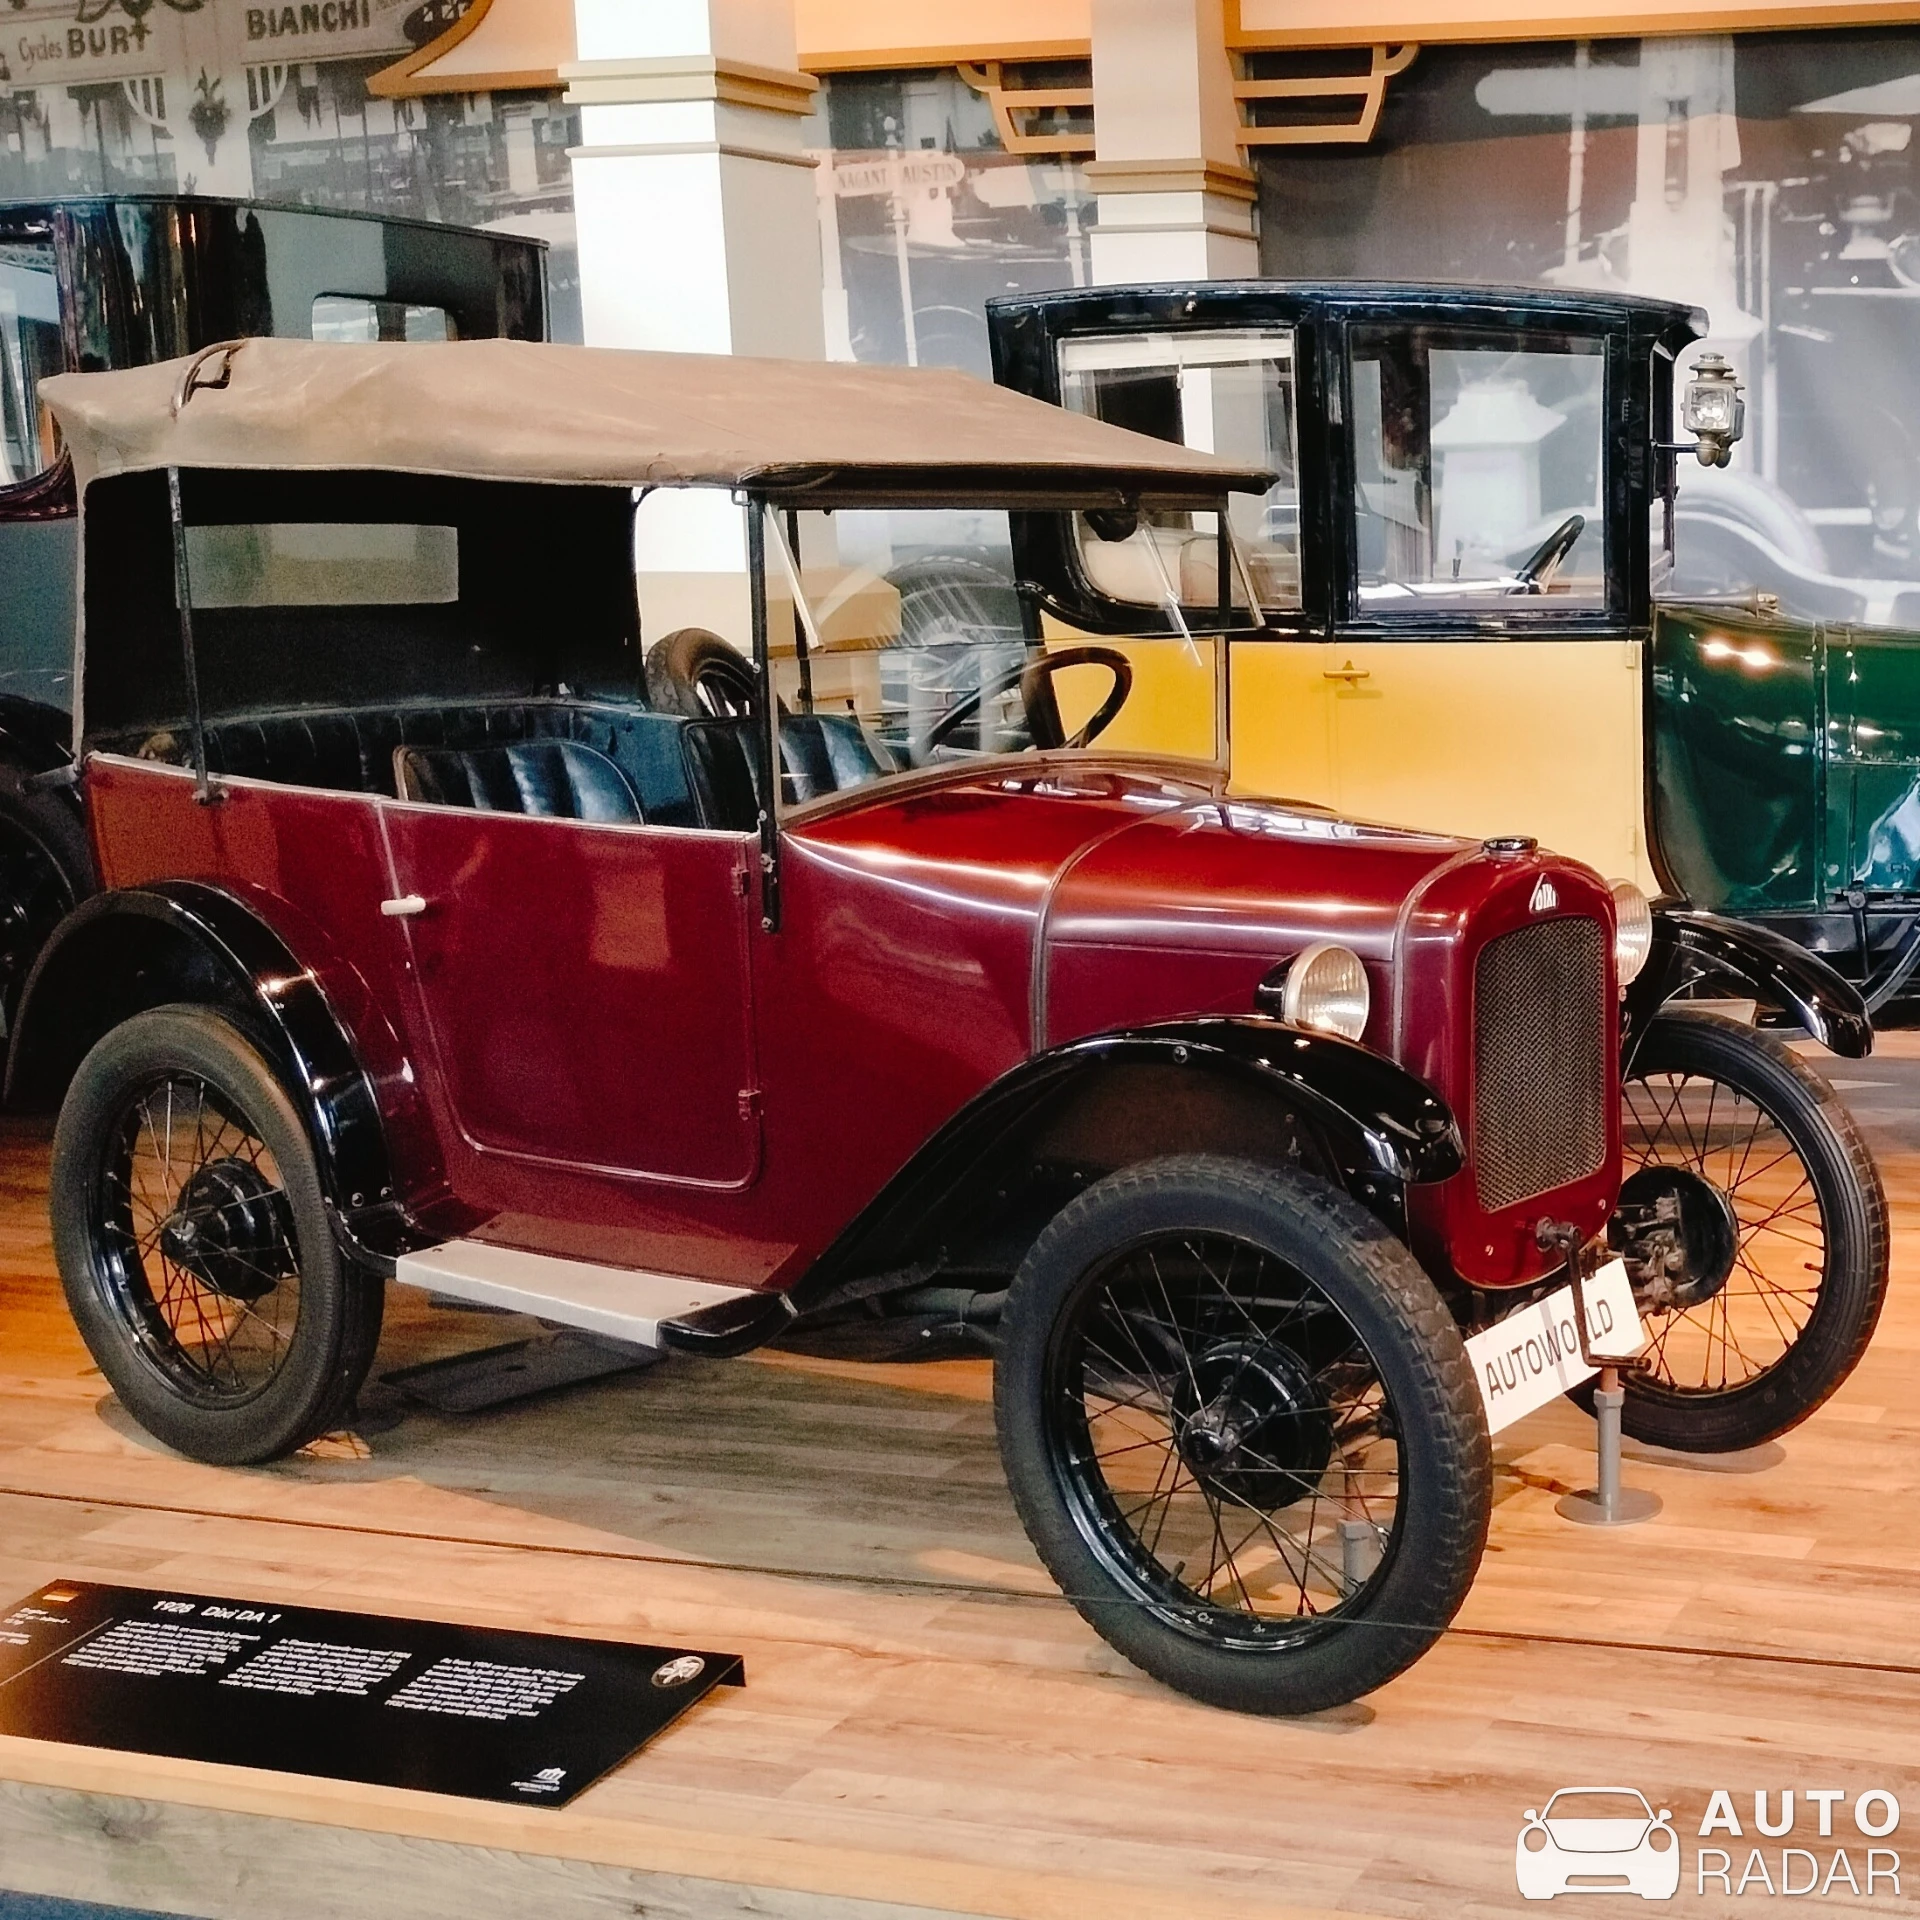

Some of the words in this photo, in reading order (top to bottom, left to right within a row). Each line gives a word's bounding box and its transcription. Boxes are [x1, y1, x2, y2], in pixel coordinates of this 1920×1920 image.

[246, 0, 370, 40] BIANCHI
[19, 34, 62, 72] Cycles
[903, 163, 957, 183] AUSTIN
[1485, 1298, 1613, 1401] AUTOWOLD
[153, 1600, 195, 1614] 1928
[235, 1610, 265, 1622] DA
[268, 1614, 281, 1623] 1
